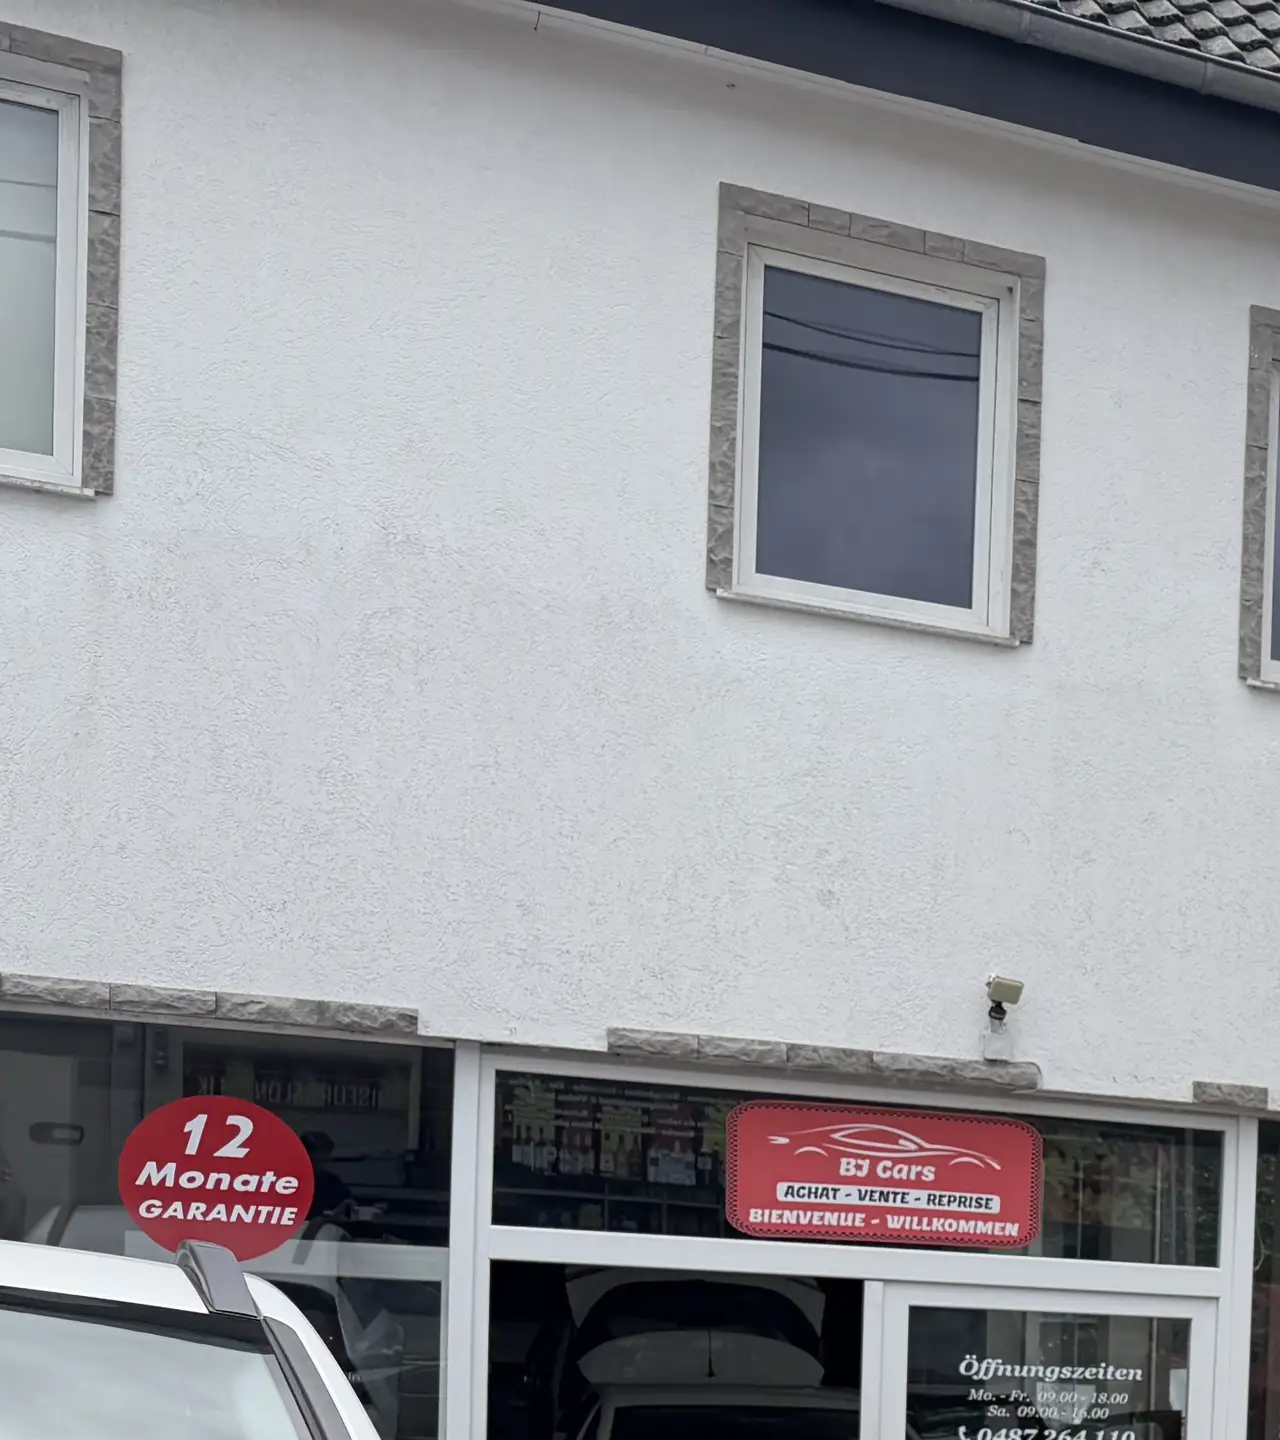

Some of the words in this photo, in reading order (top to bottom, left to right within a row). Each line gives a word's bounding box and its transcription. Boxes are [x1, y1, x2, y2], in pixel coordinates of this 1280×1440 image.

[183, 1114, 254, 1158] 12
[135, 1161, 299, 1195] Monate
[839, 1157, 870, 1178] BJ
[876, 1160, 937, 1182] Cars
[783, 1184, 841, 1201] ACHAT
[857, 1188, 910, 1205] VENTE
[926, 1193, 994, 1210] REPRISE
[138, 1199, 298, 1226] GARANTIE
[748, 1207, 866, 1228] BIENVENUE
[886, 1214, 1020, 1238] WILLKOMMEN
[958, 1354, 1144, 1382] Öffnungszeiten
[967, 1388, 997, 1402] Mo.
[1008, 1389, 1031, 1402] Fr.
[1038, 1391, 1078, 1405] 09.00
[1091, 1392, 1129, 1405] 18.00
[986, 1404, 1011, 1418] Sa.
[1016, 1405, 1058, 1419] 09.00
